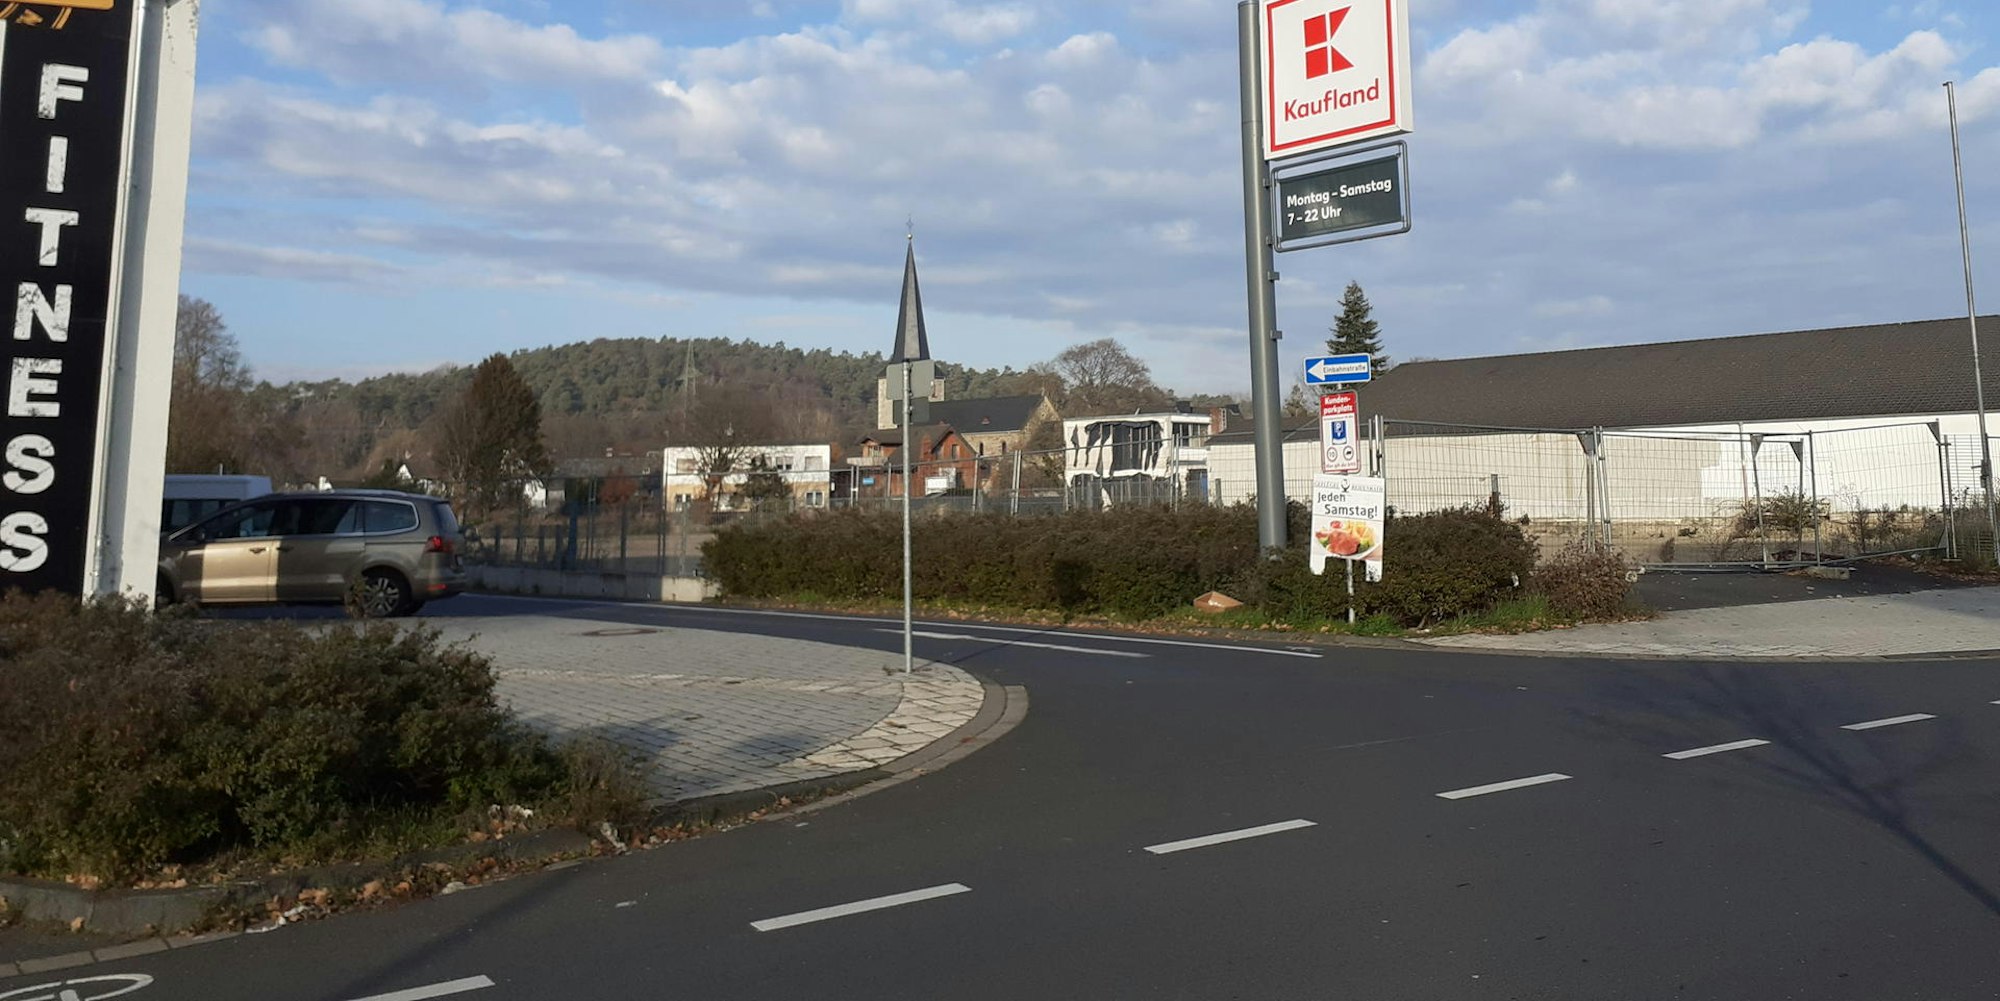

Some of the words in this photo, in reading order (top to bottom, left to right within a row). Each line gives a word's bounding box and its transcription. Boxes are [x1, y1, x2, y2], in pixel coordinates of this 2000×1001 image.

[1284, 78, 1379, 122] Kaufland
[1286, 191, 1330, 208] Montag
[1340, 179, 1392, 198] Samstag
[1287, 213, 1295, 225] 7
[1304, 208, 1319, 222] 22
[1321, 206, 1342, 220] Uhr
[0, 63, 89, 572] FITNESS
[1324, 395, 1350, 405] Kunden-
[1323, 405, 1353, 415] parkplatz
[1317, 492, 1346, 503] Jeden
[1324, 504, 1378, 519] Samstag!
